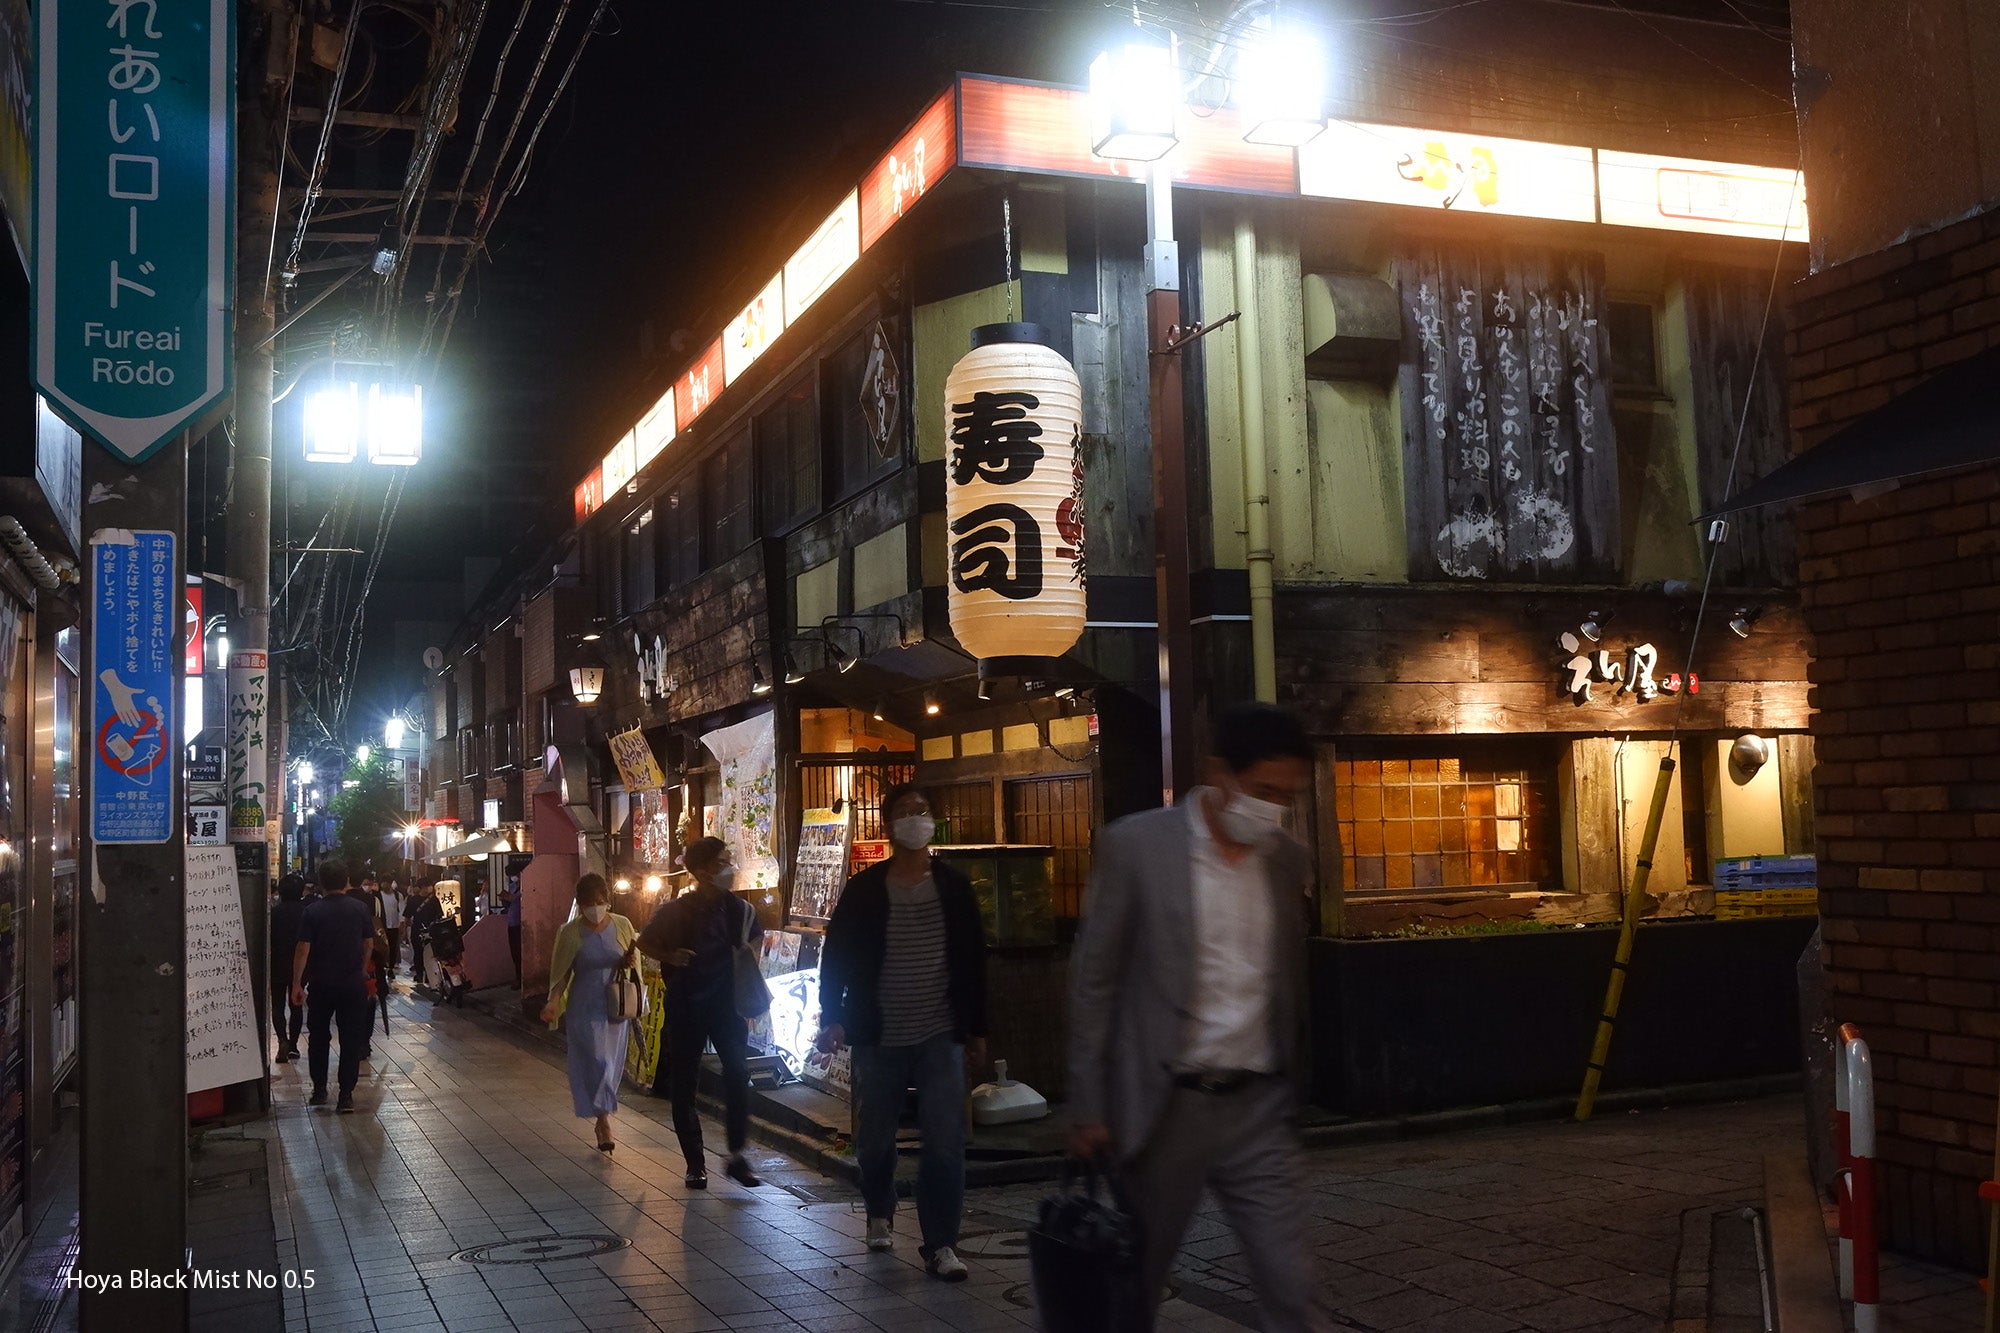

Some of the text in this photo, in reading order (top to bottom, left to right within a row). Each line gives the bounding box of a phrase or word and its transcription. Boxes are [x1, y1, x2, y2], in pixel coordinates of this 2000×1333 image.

[84, 322, 181, 352] Fureai
[92, 358, 175, 386] Rōdo
[950, 391, 1044, 600] 寿司
[103, 544, 116, 616] めましょう。
[231, 694, 248, 782] ハウジング
[249, 675, 265, 750] マツザキ
[116, 791, 149, 800] 中野区
